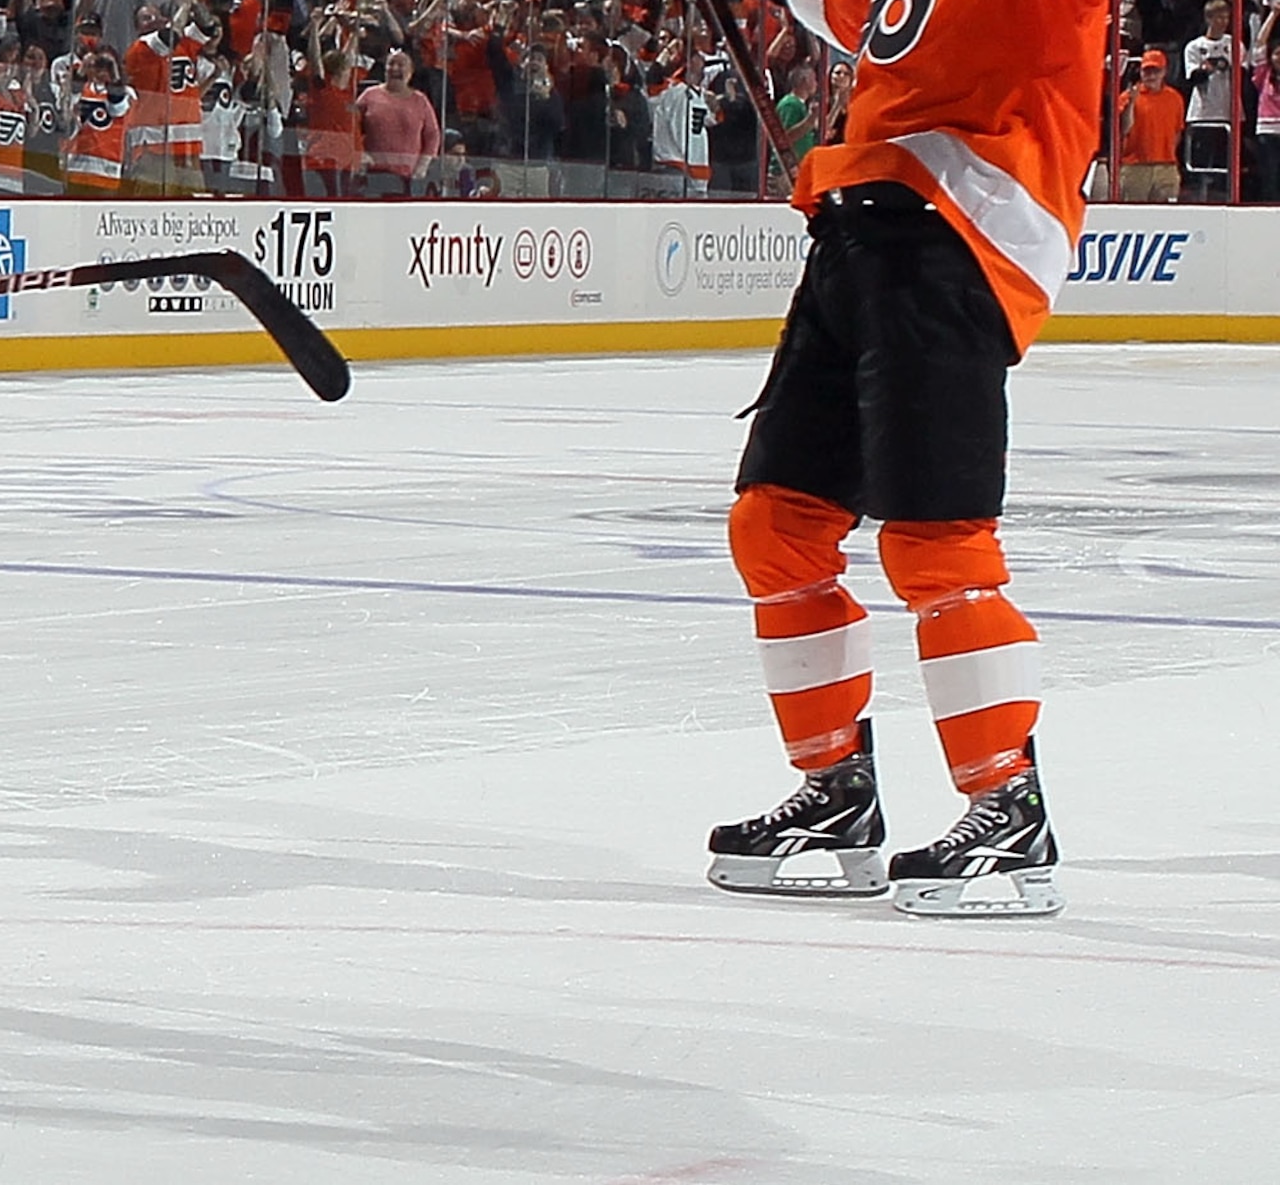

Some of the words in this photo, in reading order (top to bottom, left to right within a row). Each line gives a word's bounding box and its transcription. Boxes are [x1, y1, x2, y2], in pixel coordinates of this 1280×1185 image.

[96, 212, 146, 243] Always
[150, 219, 159, 237] a
[162, 212, 184, 243] big
[186, 212, 239, 243] jackpot.
[255, 210, 334, 278] $175
[408, 222, 503, 288] xfinity
[150, 296, 202, 311] POWER
[203, 297, 238, 311] PLAY
